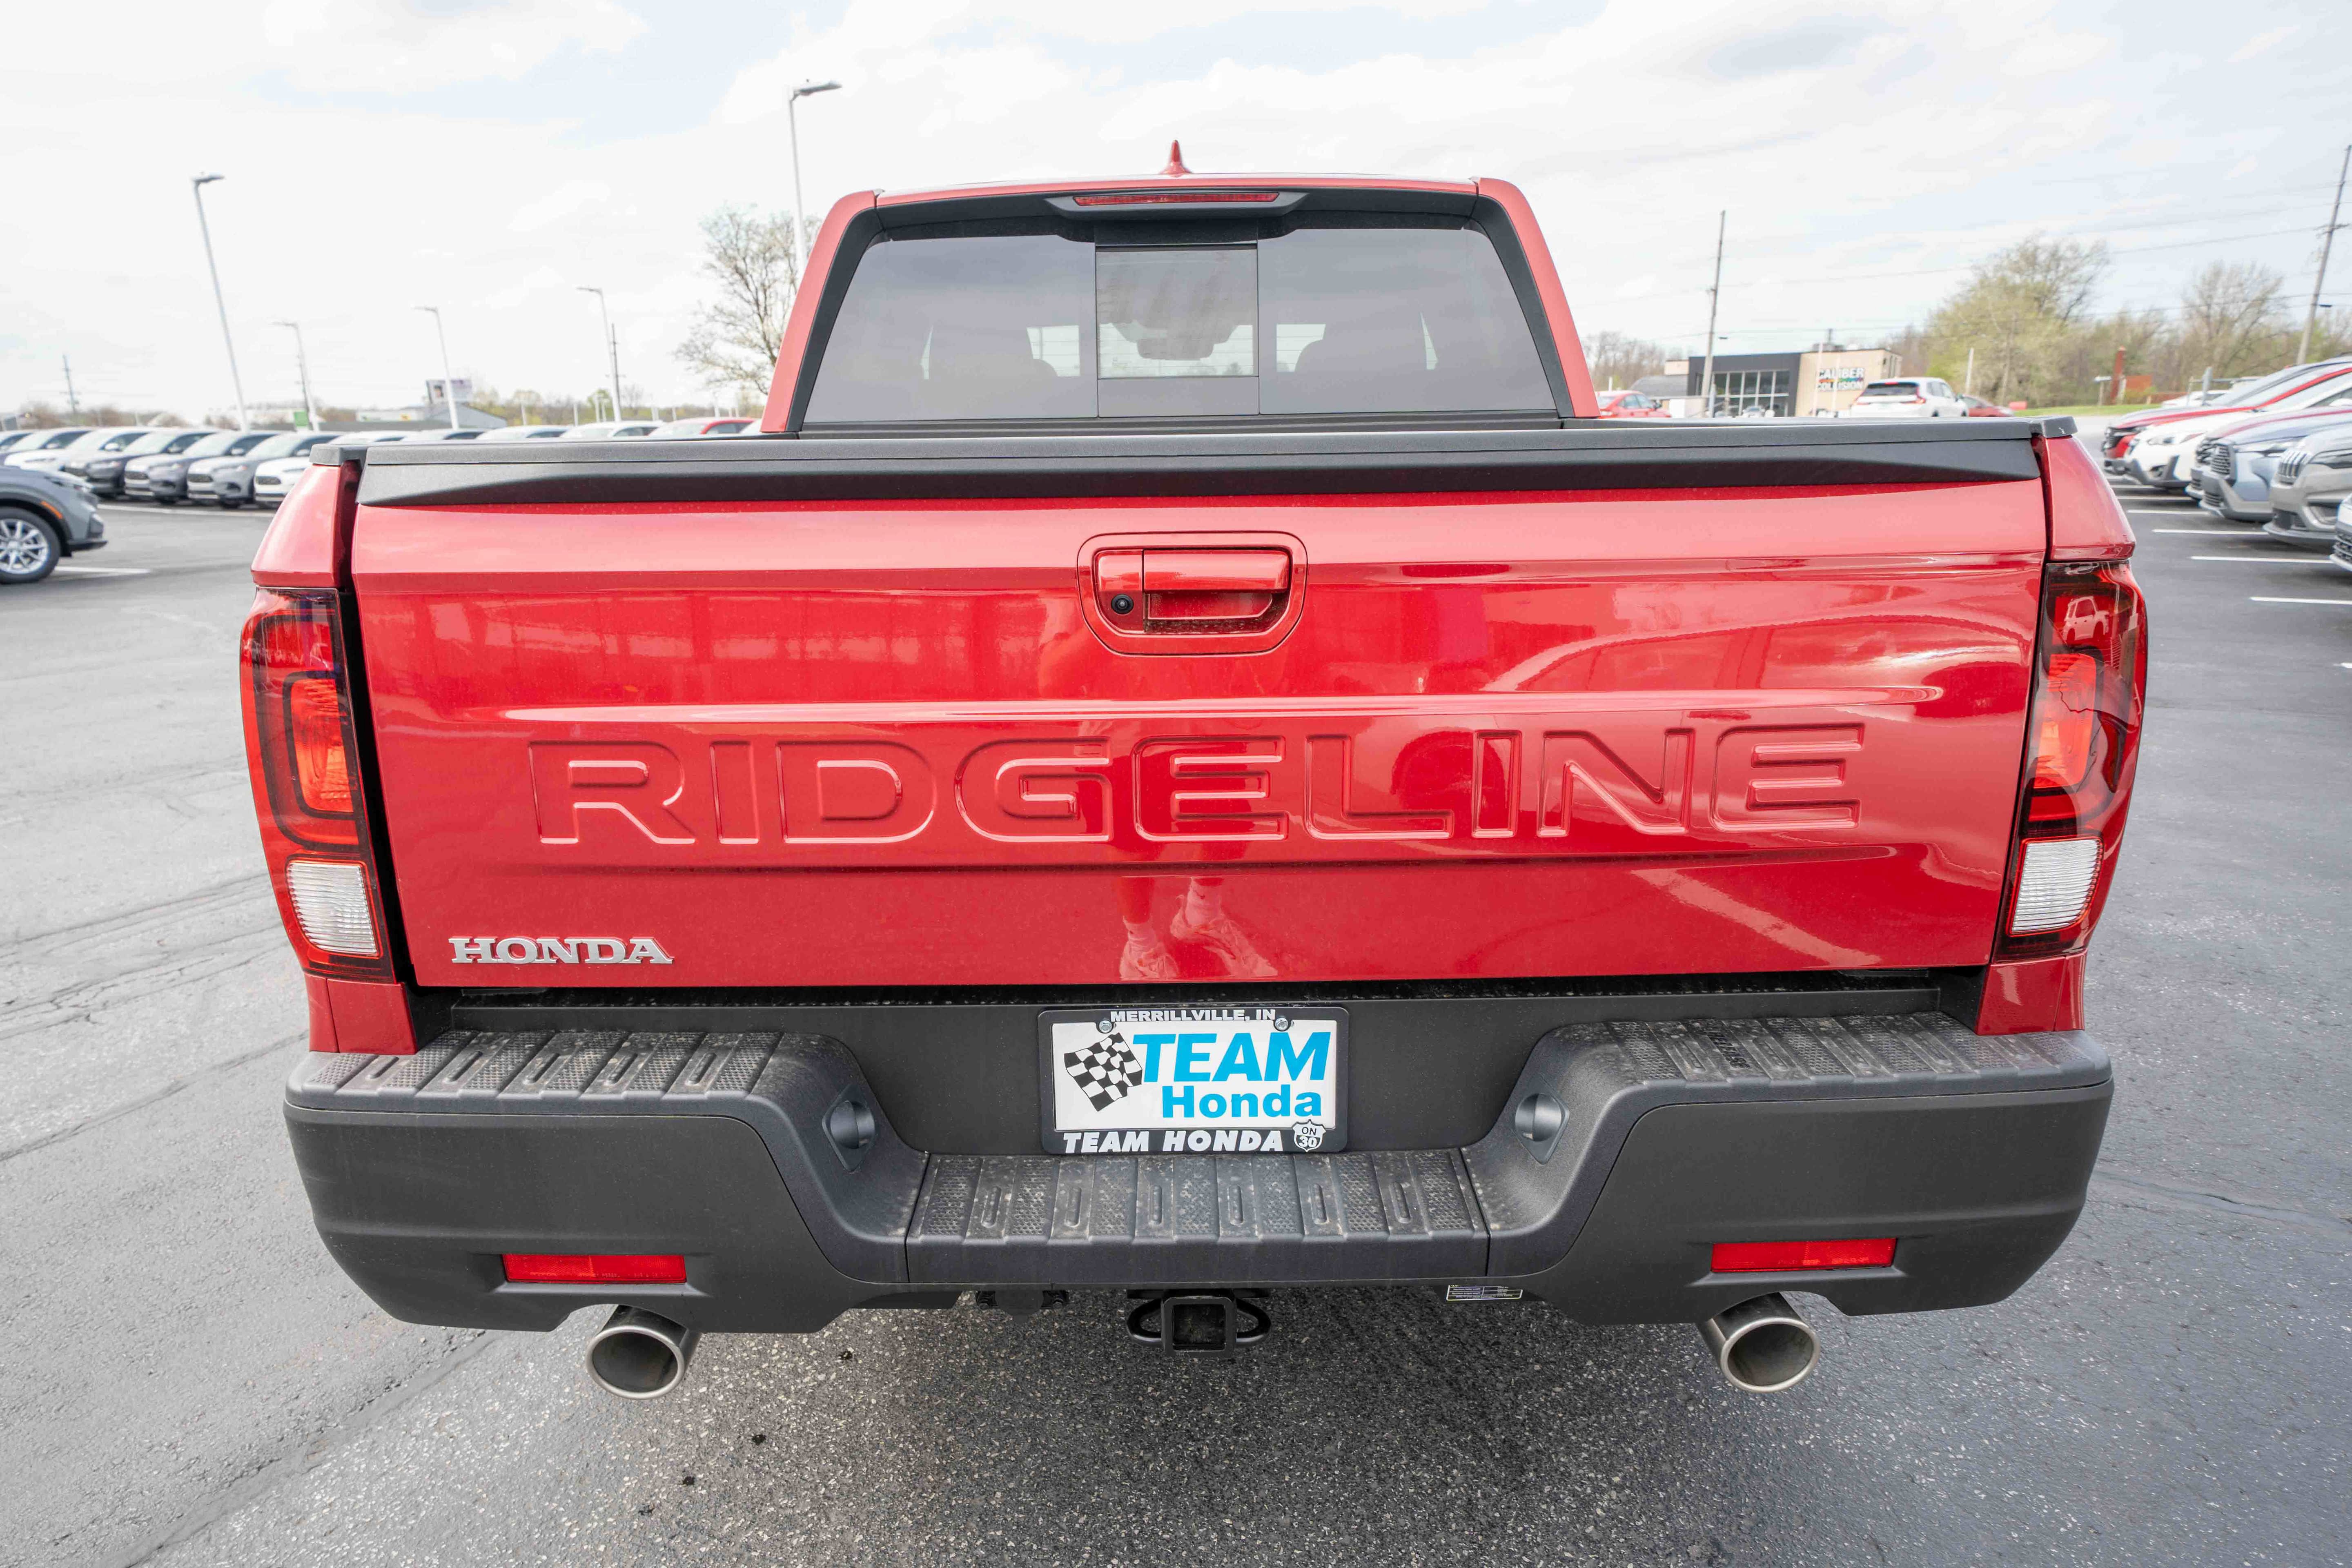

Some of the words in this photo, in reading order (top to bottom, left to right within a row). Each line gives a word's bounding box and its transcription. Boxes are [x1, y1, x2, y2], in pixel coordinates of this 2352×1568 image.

[529, 722, 1865, 845] RIDGELINE
[448, 938, 675, 964] HONDA
[1110, 1010, 1250, 1022] MERRILLVILLE,
[1256, 1009, 1276, 1020] IN
[1132, 1032, 1331, 1083] TEAM
[1162, 1084, 1322, 1119] Honda
[1063, 1131, 1149, 1154] TEAM
[1163, 1130, 1284, 1153] HONDA
[1298, 1136, 1318, 1147] 30
[1302, 1127, 1316, 1136] ON
